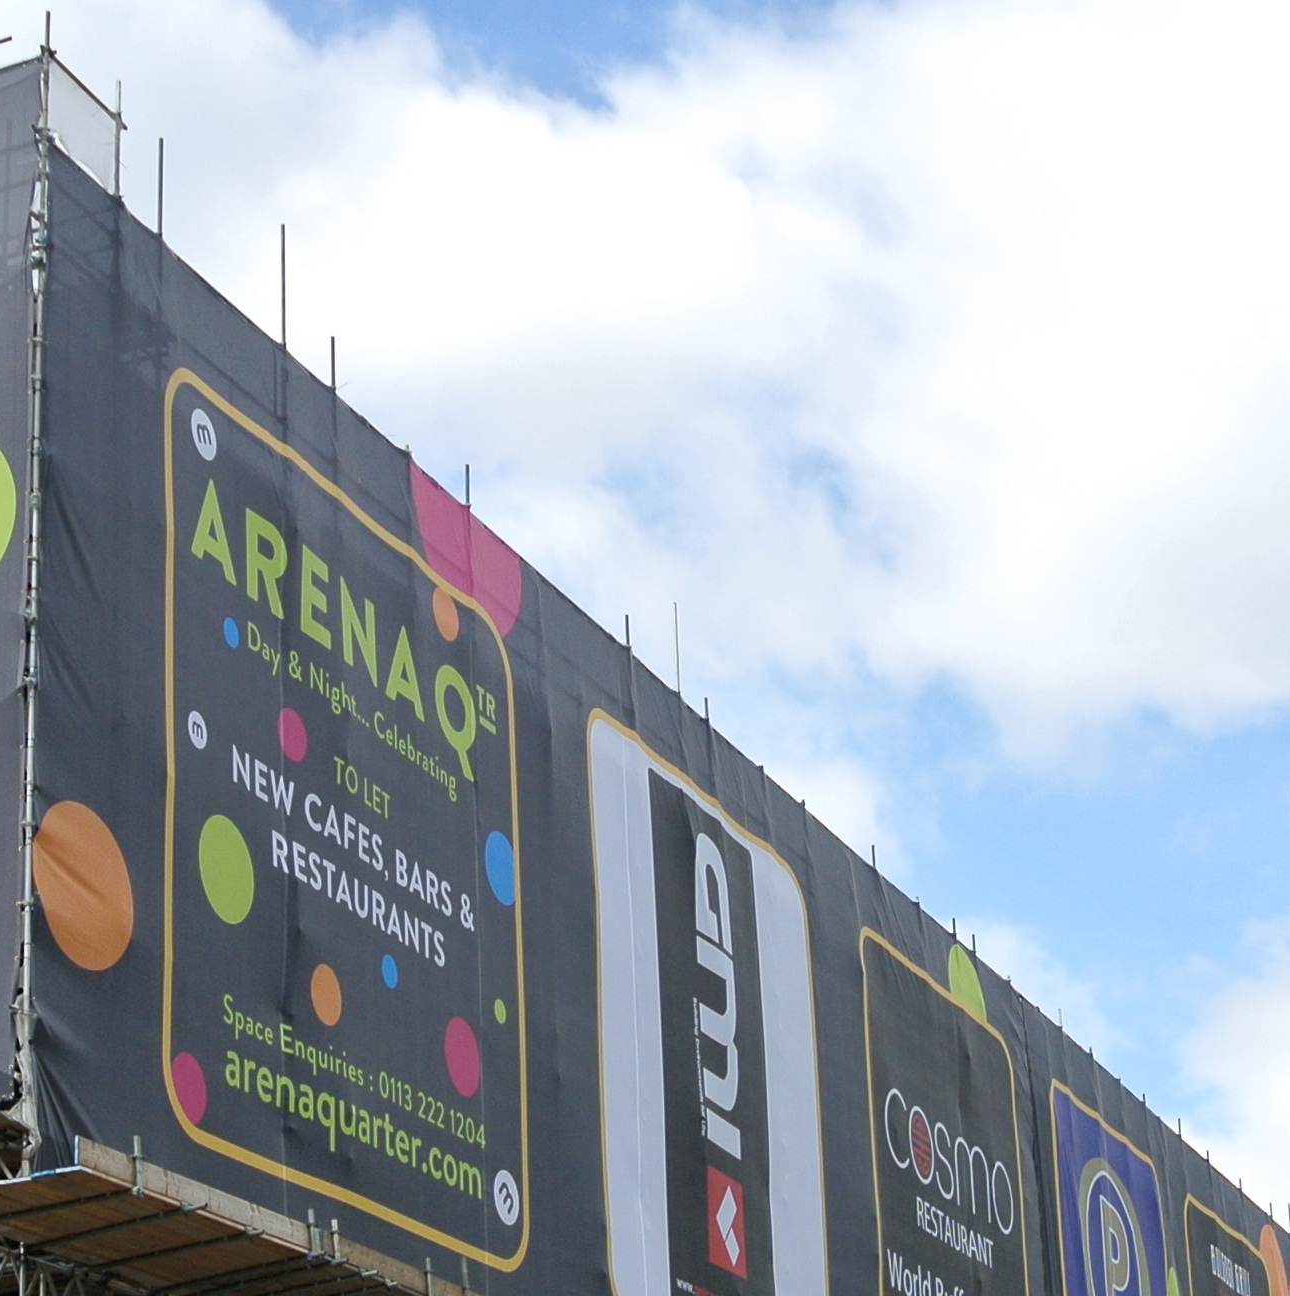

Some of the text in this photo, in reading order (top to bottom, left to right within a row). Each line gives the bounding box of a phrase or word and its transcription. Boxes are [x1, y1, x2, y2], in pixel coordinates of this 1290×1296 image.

[247, 621, 280, 675] Day
[288, 650, 302, 682] &
[374, 710, 457, 802] Celebrating
[232, 744, 475, 931] NEW CAFES, BARS &
[333, 756, 390, 819] TO LET
[271, 829, 446, 967] RESTAURANTS
[222, 994, 486, 1149] Space Enquiries 0113 222 1204
[225, 1050, 484, 1200] arenaquarter.com
[916, 1195, 994, 1269] RESTAURANT
